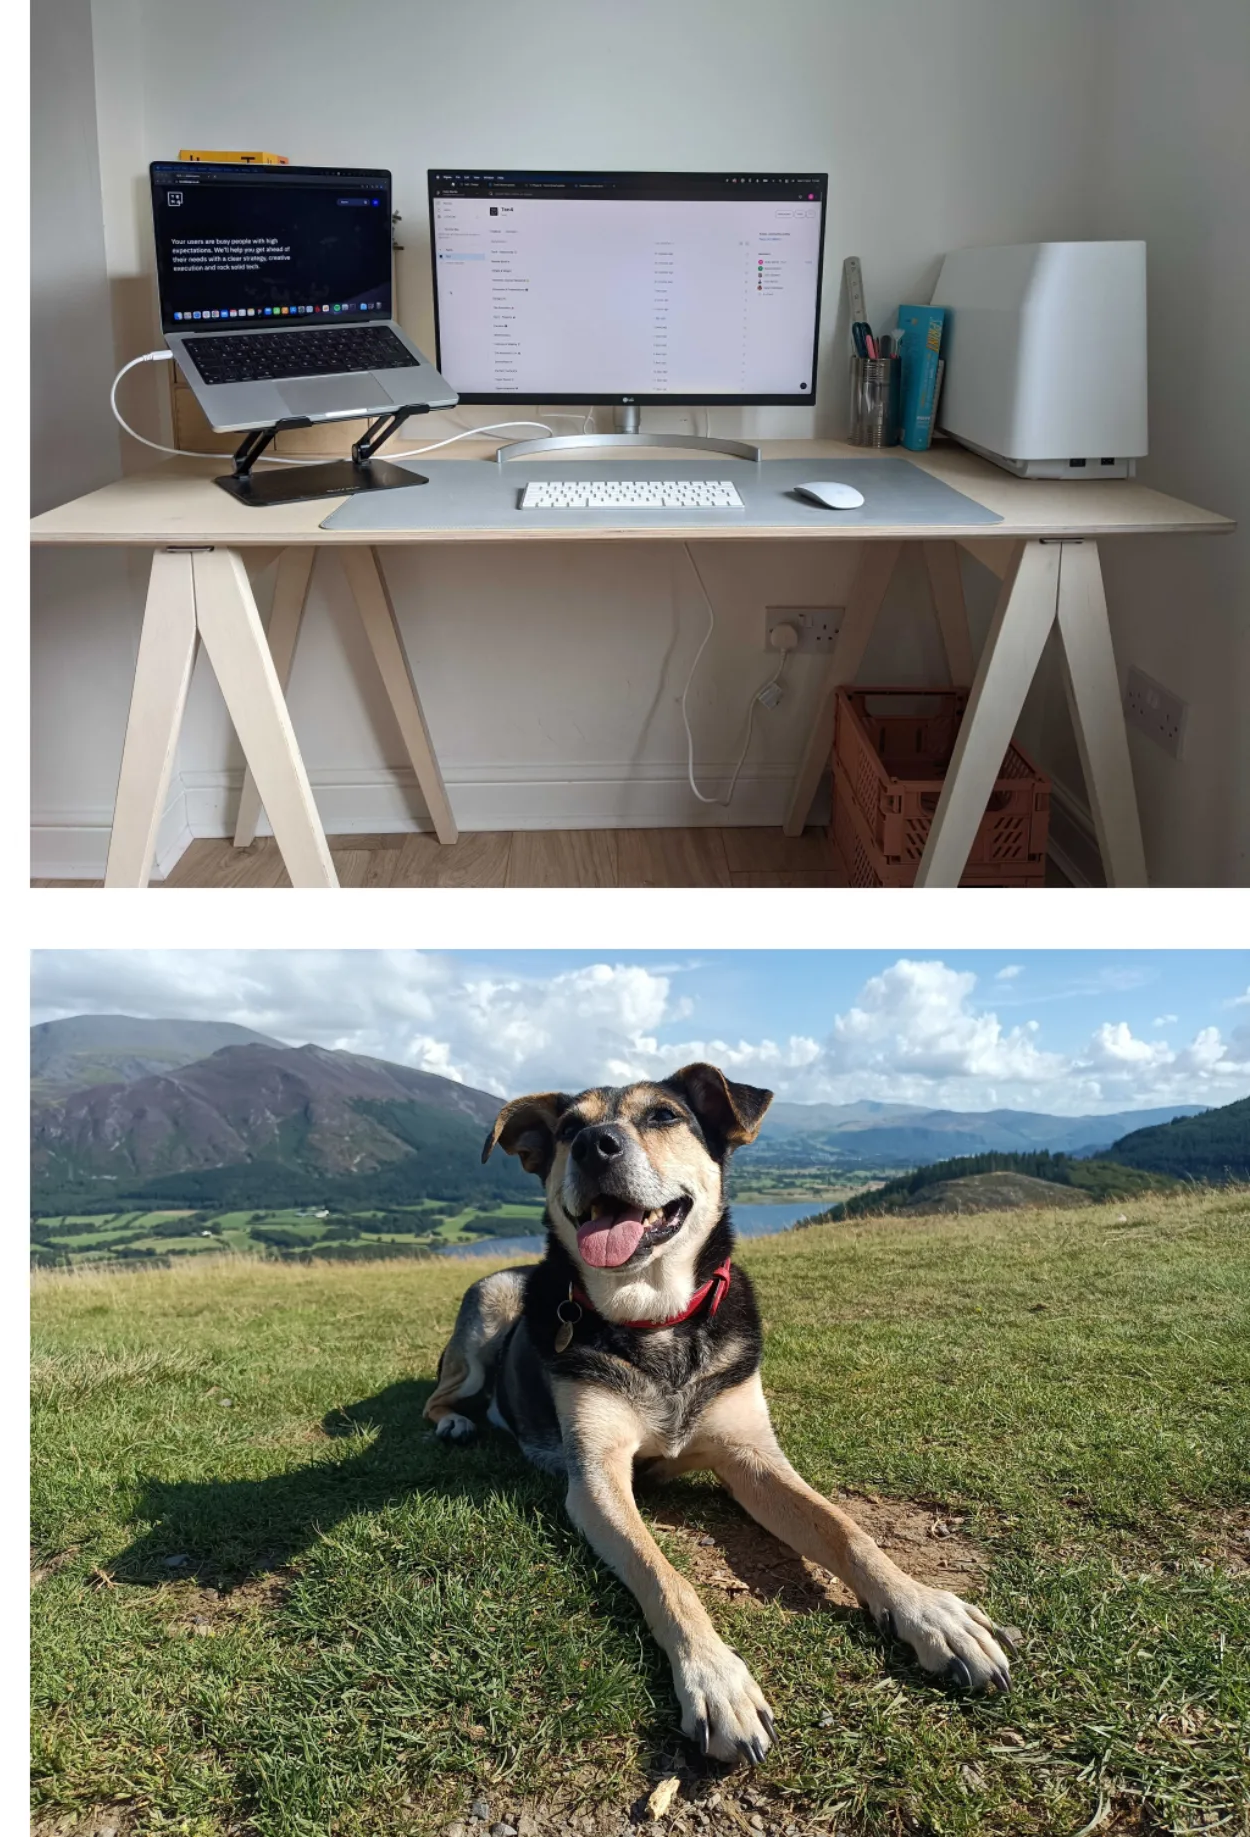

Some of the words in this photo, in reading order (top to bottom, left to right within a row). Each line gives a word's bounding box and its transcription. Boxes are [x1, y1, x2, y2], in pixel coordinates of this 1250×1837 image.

[216, 238, 230, 246] busy
[231, 238, 251, 246] people
[230, 246, 243, 254] help
[256, 246, 265, 254] get
[926, 316, 942, 353] SPRINT
